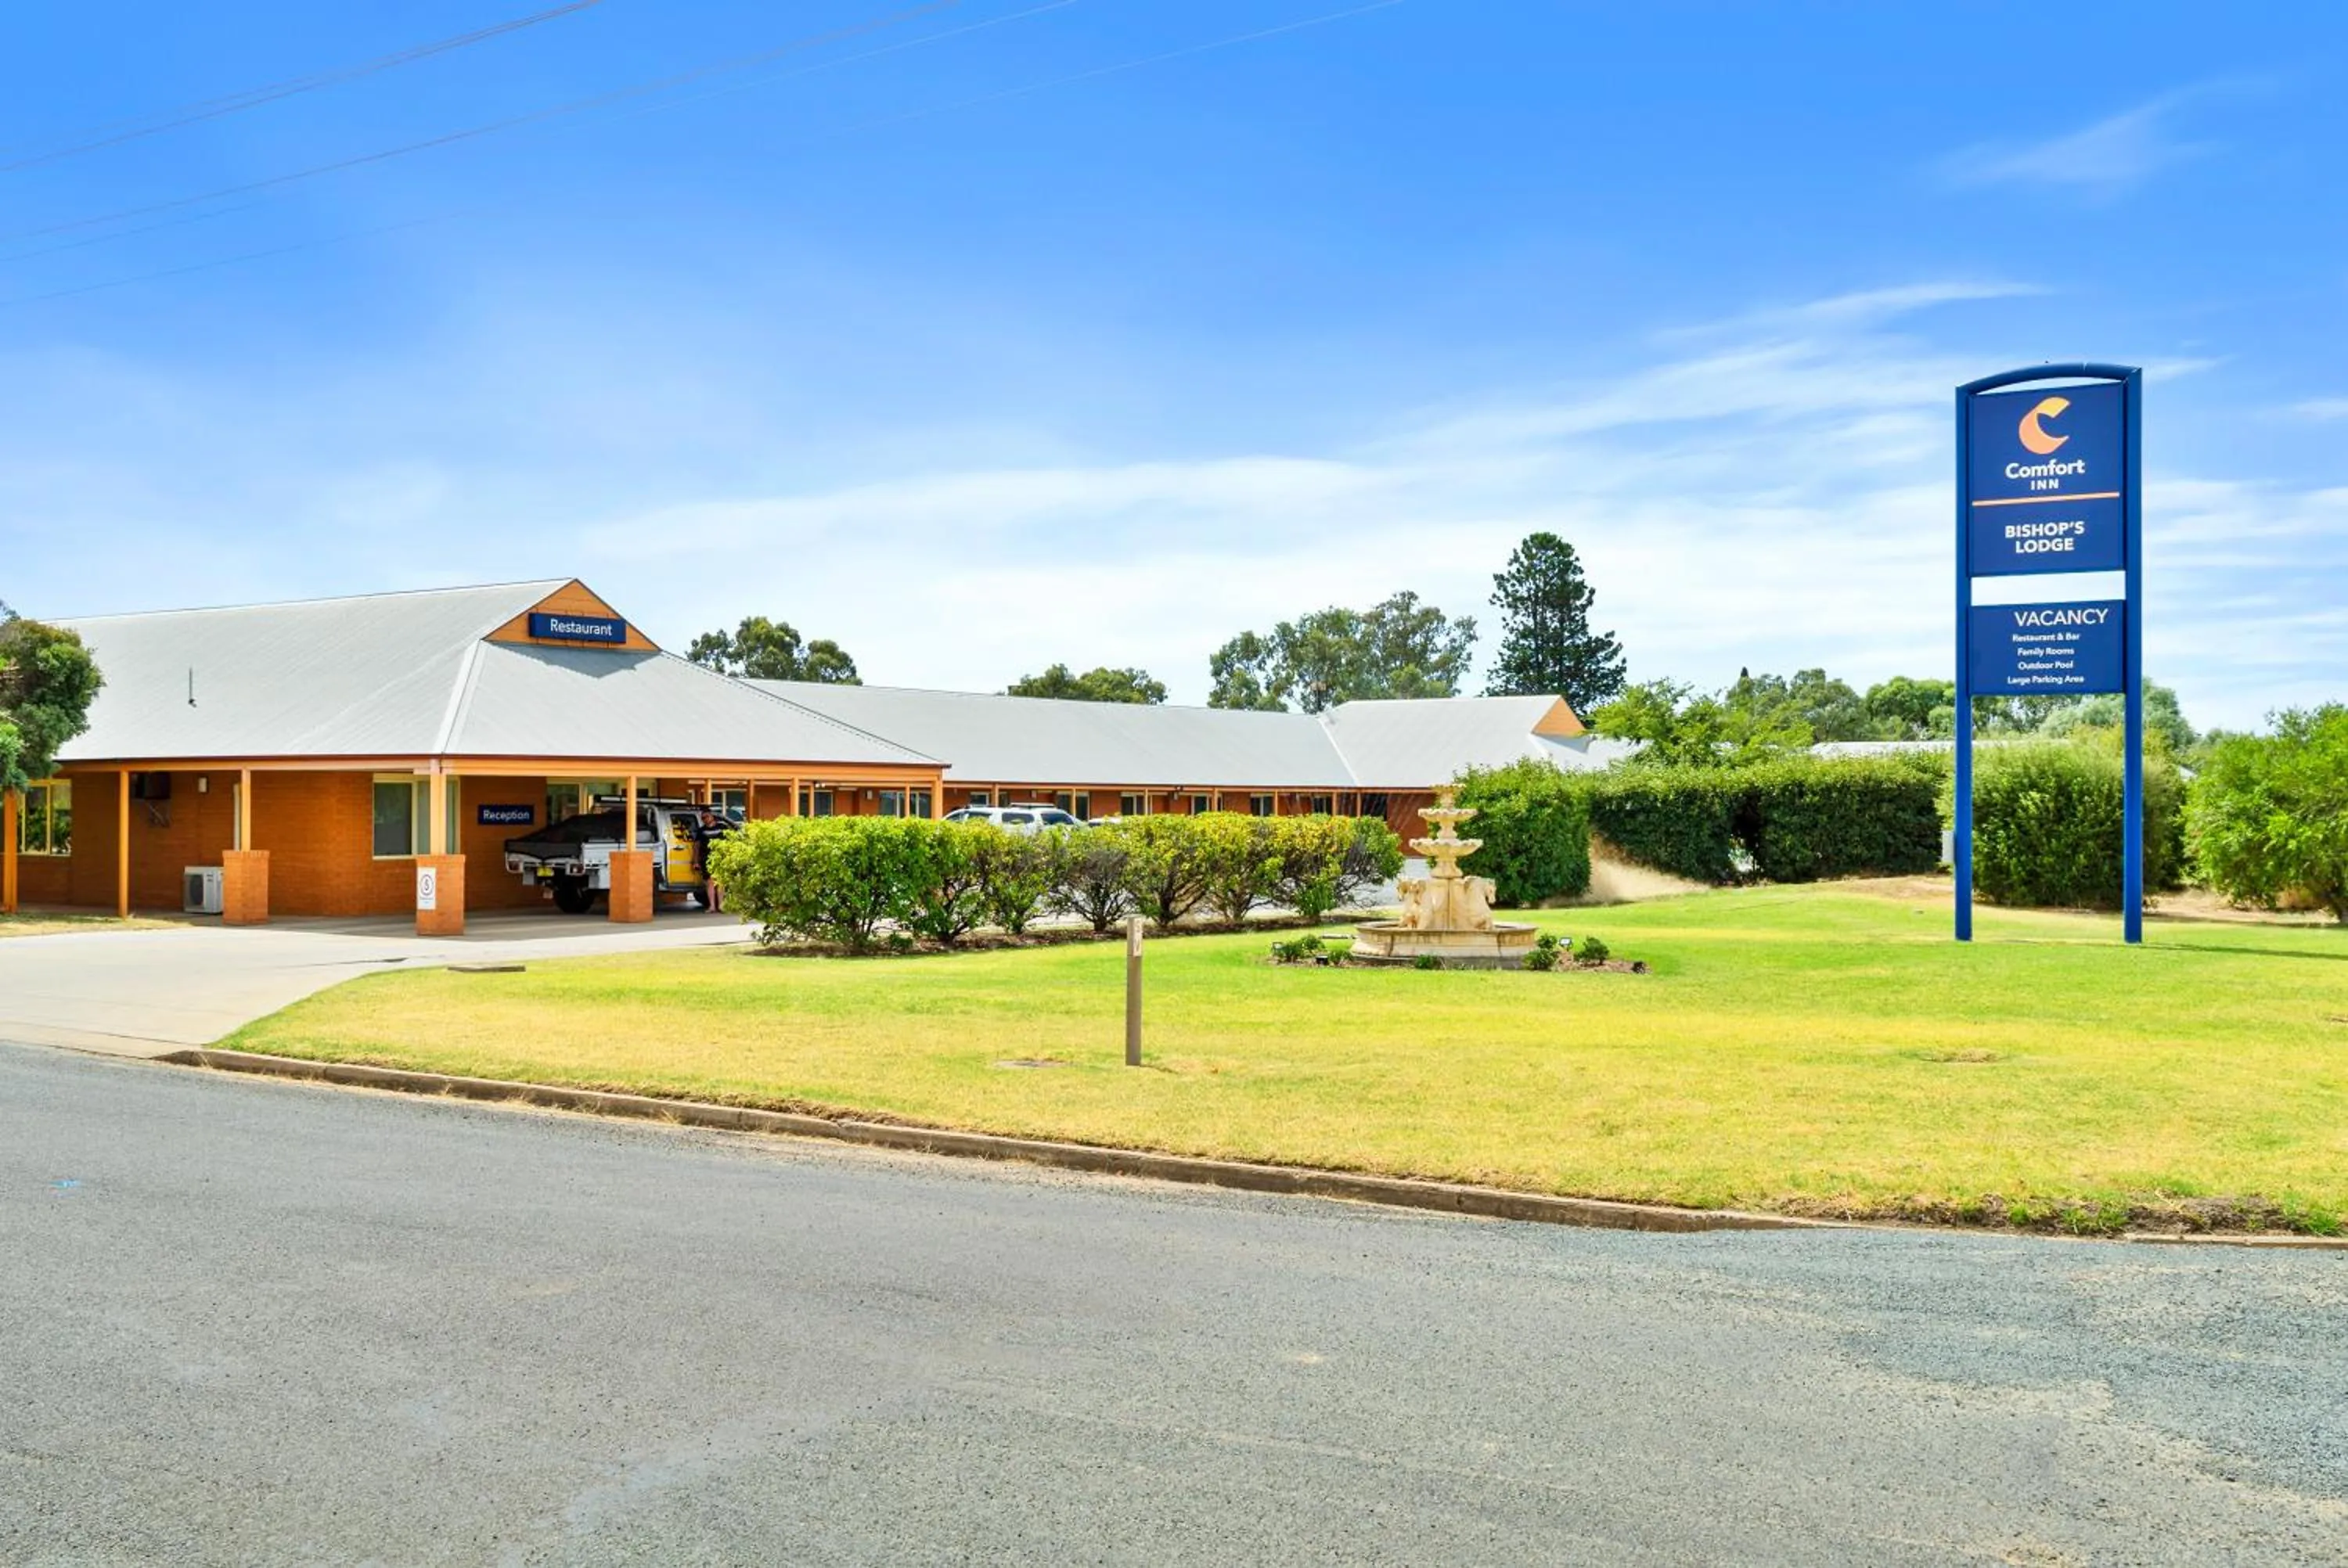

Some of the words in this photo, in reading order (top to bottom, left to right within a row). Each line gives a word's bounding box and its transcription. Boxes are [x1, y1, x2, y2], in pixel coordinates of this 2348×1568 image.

[2004, 459, 2085, 479] Comfort
[2030, 479, 2059, 491] INN
[2004, 521, 2085, 538] BISHOP'S
[2015, 538, 2074, 553] LODGE
[2014, 609, 2109, 627] VACANCY
[550, 618, 612, 636] Restaurant
[2012, 634, 2055, 642] Restaurant
[2065, 632, 2080, 641] Bar
[2017, 648, 2044, 658] Family
[2046, 647, 2075, 656] Rooms
[2018, 662, 2054, 671] Outdoor
[2055, 660, 2074, 669] Pool
[2007, 676, 2030, 685] Large
[2032, 675, 2062, 685] Parking
[483, 810, 530, 822] Reception
